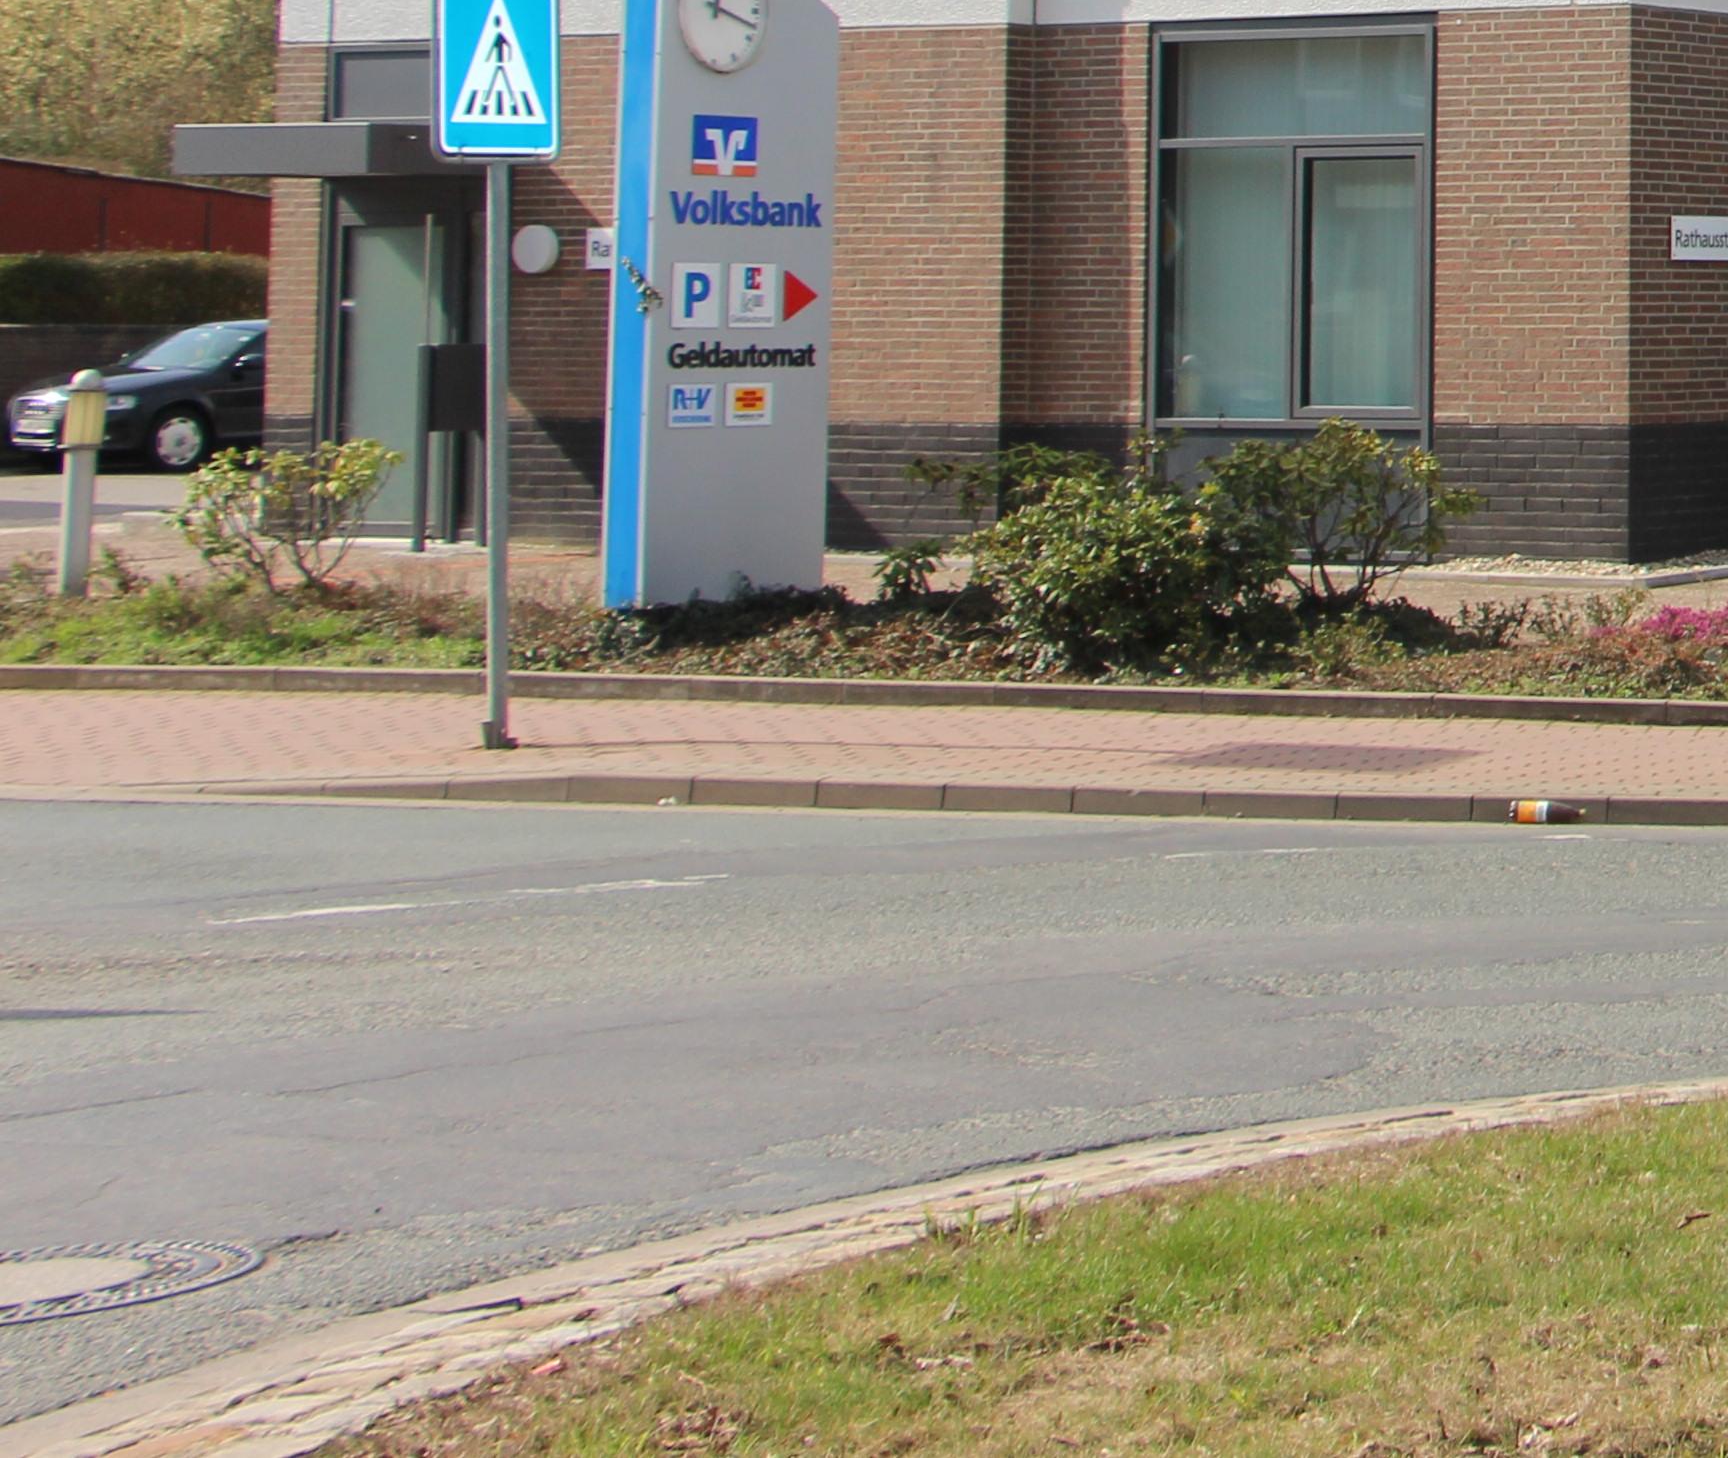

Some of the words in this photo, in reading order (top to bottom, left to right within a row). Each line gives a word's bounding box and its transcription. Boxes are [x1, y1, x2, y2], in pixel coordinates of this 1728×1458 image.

[669, 190, 822, 228] Volksbank
[591, 240, 613, 257] Ra
[684, 272, 711, 318] P
[668, 341, 816, 369] Geldautomat
[673, 388, 711, 410] R+V
